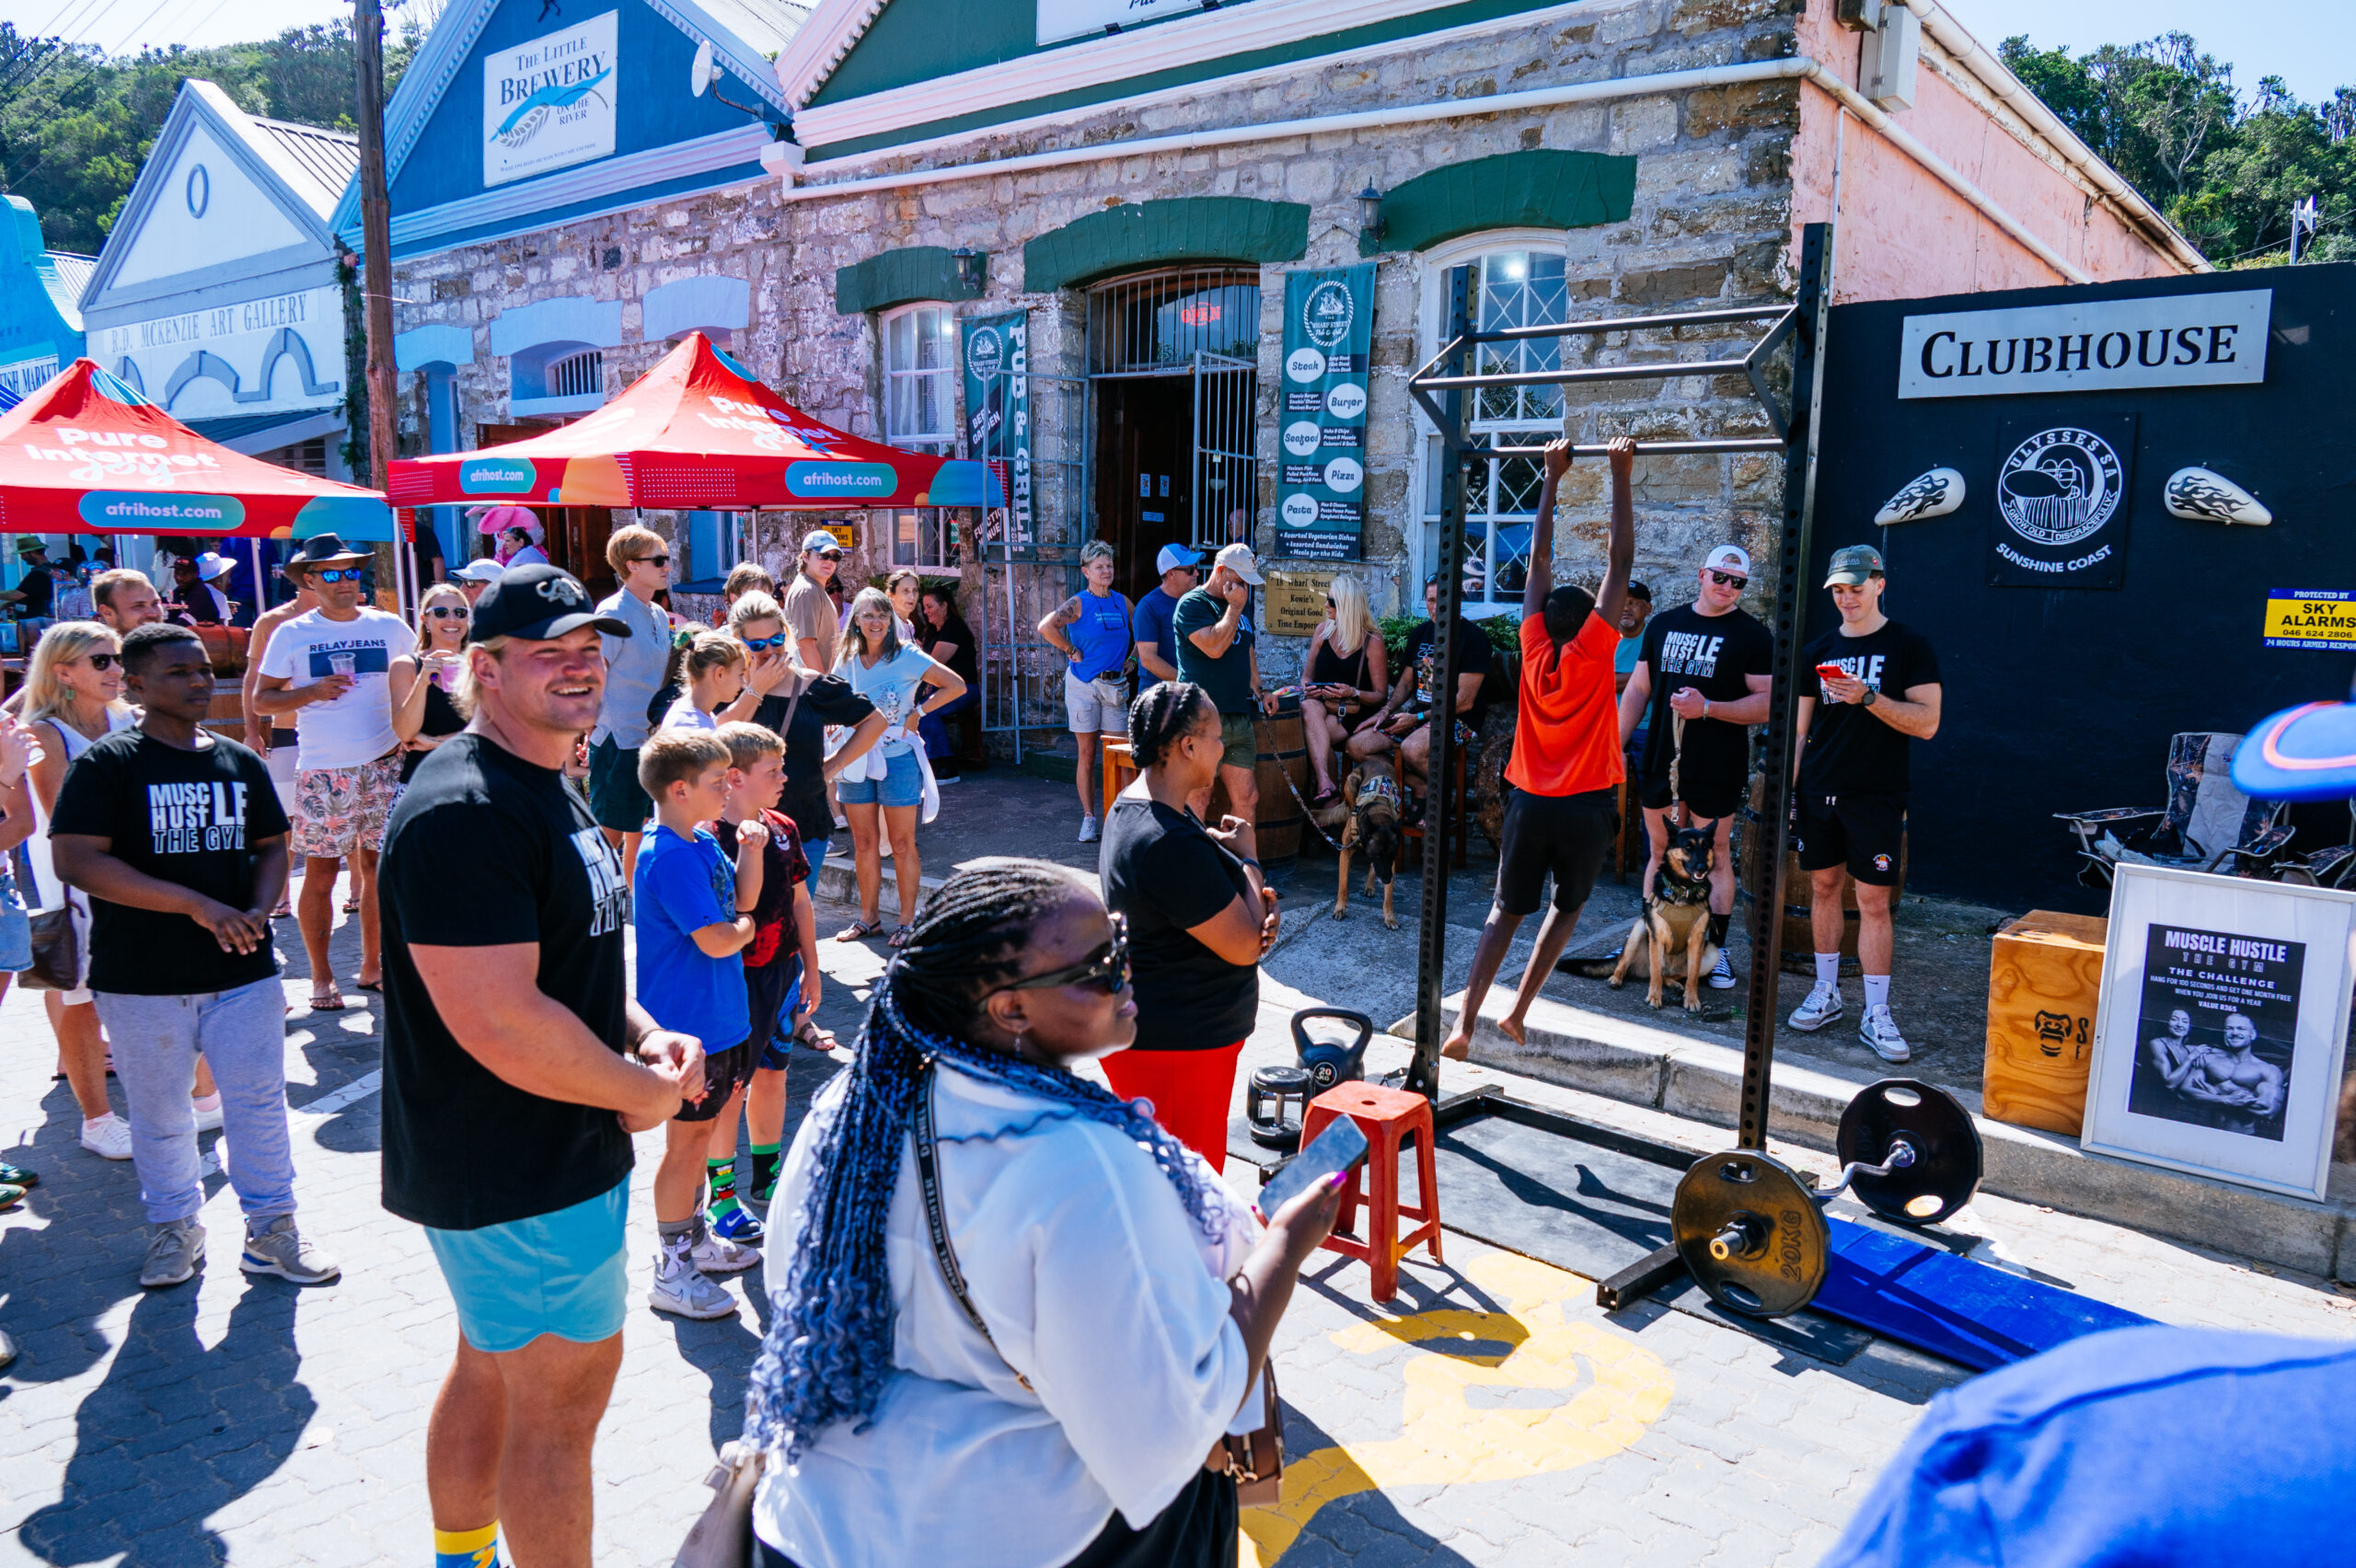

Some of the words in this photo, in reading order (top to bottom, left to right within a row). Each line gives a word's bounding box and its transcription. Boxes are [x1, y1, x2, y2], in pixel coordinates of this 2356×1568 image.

[516, 53, 540, 71] THE
[544, 36, 588, 63] LITTLE
[500, 51, 606, 106] BREWERY
[572, 97, 590, 111] THE
[560, 110, 587, 125] RIVER
[111, 329, 133, 352] R.D.
[141, 315, 200, 348] MCKENZIE
[210, 307, 235, 337] ART
[244, 294, 307, 331] GALLERY
[1181, 306, 1220, 323] OPEN
[1921, 324, 2239, 378] CLUBHOUSE
[1010, 324, 1027, 399] PUB
[1292, 361, 1319, 371] Steak
[708, 396, 791, 422] Pure
[1331, 397, 1363, 409] Burger
[1014, 410, 1027, 436] &
[55, 427, 167, 449] Pure
[1285, 432, 1319, 446] Seafood
[2010, 431, 2099, 468] ULYSSES
[2099, 454, 2118, 478] SA
[470, 468, 525, 482] afrihost.com
[803, 472, 883, 487] afrihost.com
[1331, 470, 1355, 480] Pizza
[1015, 447, 1032, 552] GRILL
[106, 502, 222, 519] afrihost.com
[1287, 505, 1312, 514] Pasta
[2009, 509, 2028, 531] GROW
[2028, 527, 2046, 538] OLD
[2055, 497, 2113, 541] DISGRACEFULLY
[1995, 543, 2064, 572] SUNSHINE
[2067, 545, 2112, 571] COAST
[1311, 579, 1331, 587] Street
[1290, 594, 1314, 604] Kowie's
[2293, 591, 2338, 599] PROTECTED
[1280, 606, 1306, 617] Original
[1307, 607, 1322, 617] Good
[2303, 603, 2338, 615] SKY
[1277, 619, 1292, 628] Time
[2281, 615, 2356, 628] ALARMS
[2302, 640, 2327, 649] ARMED
[1660, 657, 1683, 674] THE
[1685, 660, 1715, 677] GYM
[152, 828, 200, 854] THE
[2165, 930, 2226, 953] MUSCLE
[2229, 939, 2287, 963] HUSTLE
[2182, 951, 2214, 965] THE
[2228, 958, 2264, 973] GYM
[2169, 967, 2194, 977] THE
[2198, 971, 2276, 989] CHALLENGE
[2189, 981, 2215, 990] SECONDS
[2254, 990, 2276, 999] MONTH
[2276, 994, 2292, 1002] FREE
[2199, 1000, 2219, 1009] VALUE
[2220, 1004, 2237, 1012] R365
[2246, 998, 2262, 1007] YEAR
[1319, 1067, 1332, 1076] 20
[1780, 1209, 1802, 1283] 20KG
